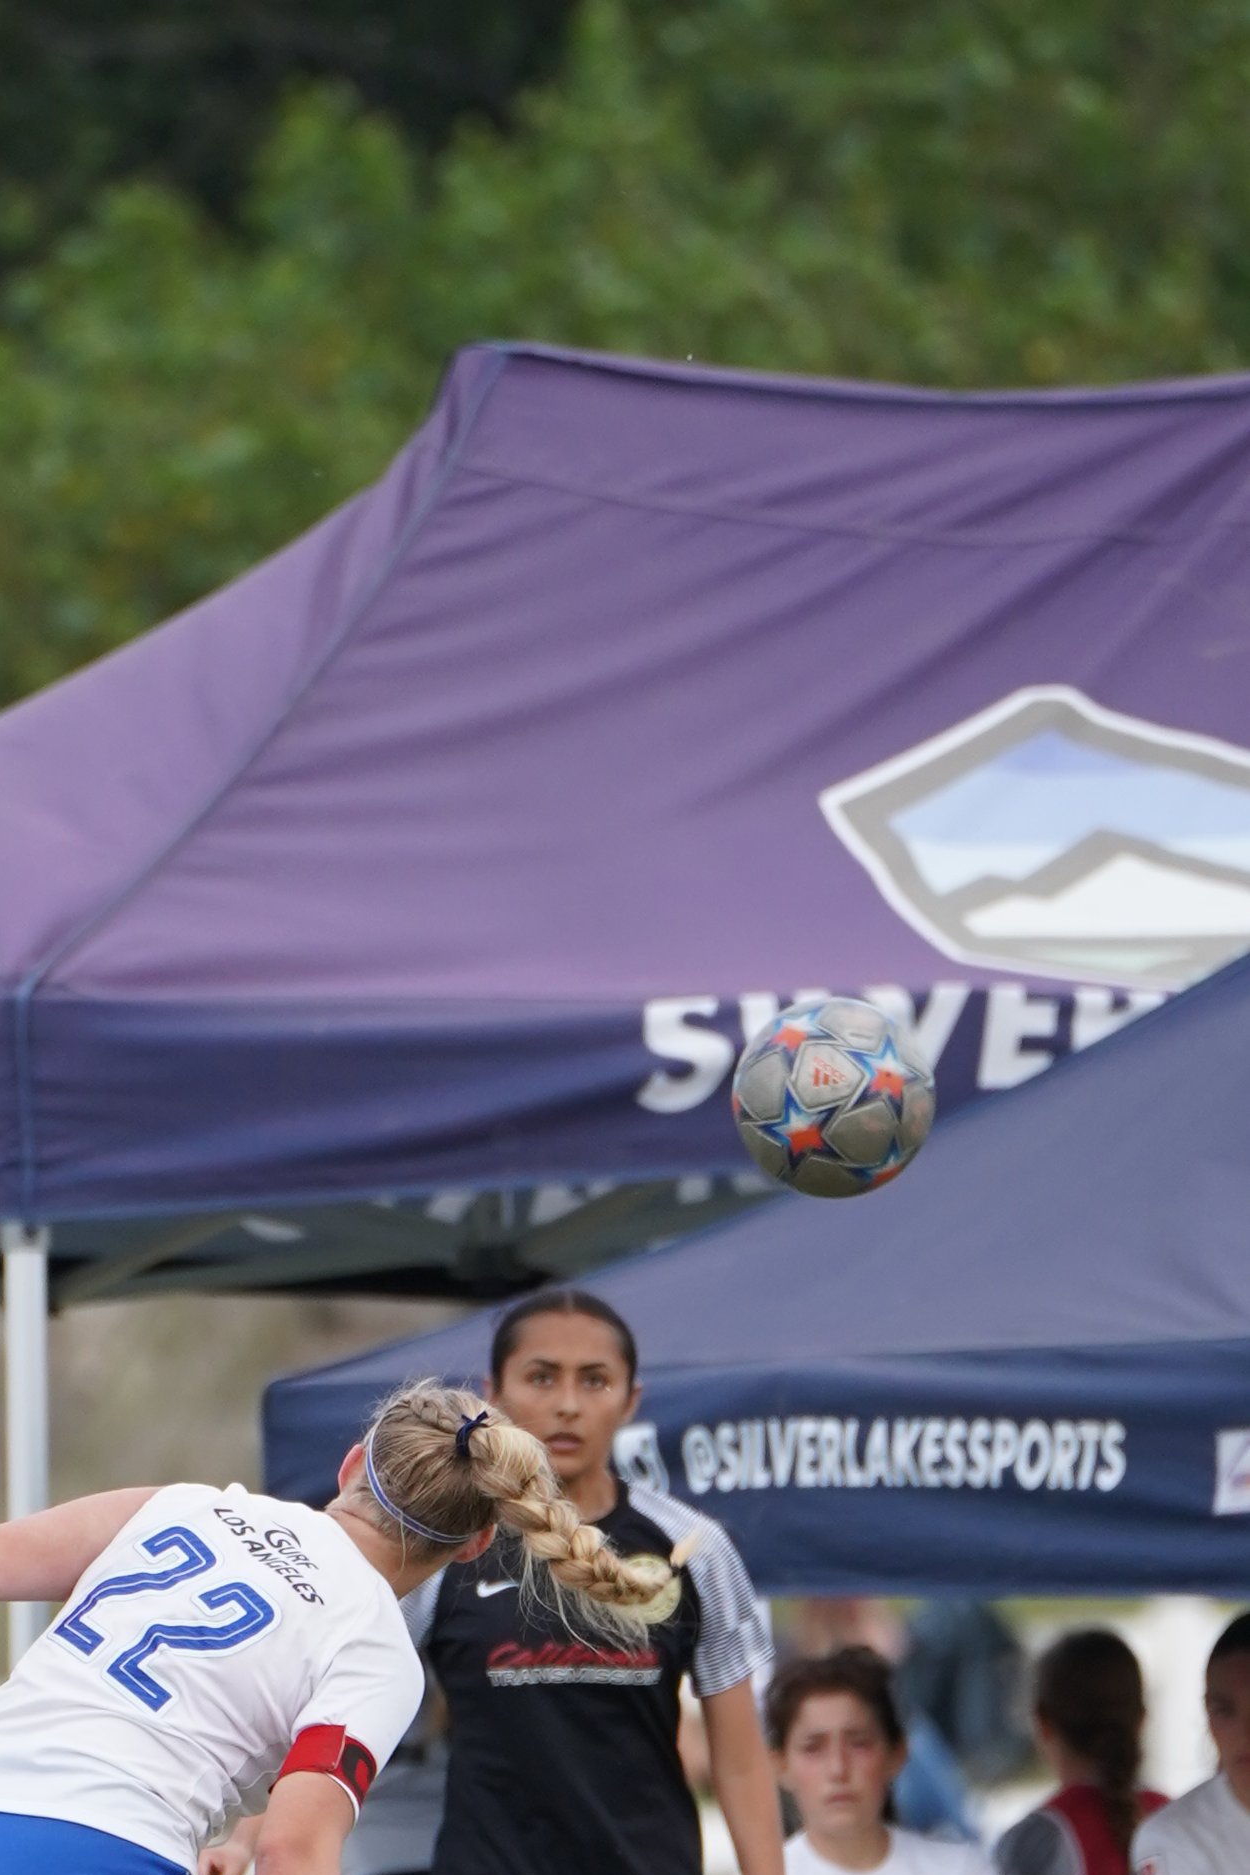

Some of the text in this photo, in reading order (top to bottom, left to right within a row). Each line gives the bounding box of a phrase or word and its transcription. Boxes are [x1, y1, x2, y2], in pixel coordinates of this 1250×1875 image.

[681, 1416, 1127, 1495] @SILVERLAKESSPORTS
[213, 1507, 325, 1606] LOS ANGELES
[265, 1529, 319, 1570] SURF
[53, 1525, 275, 1712] 22
